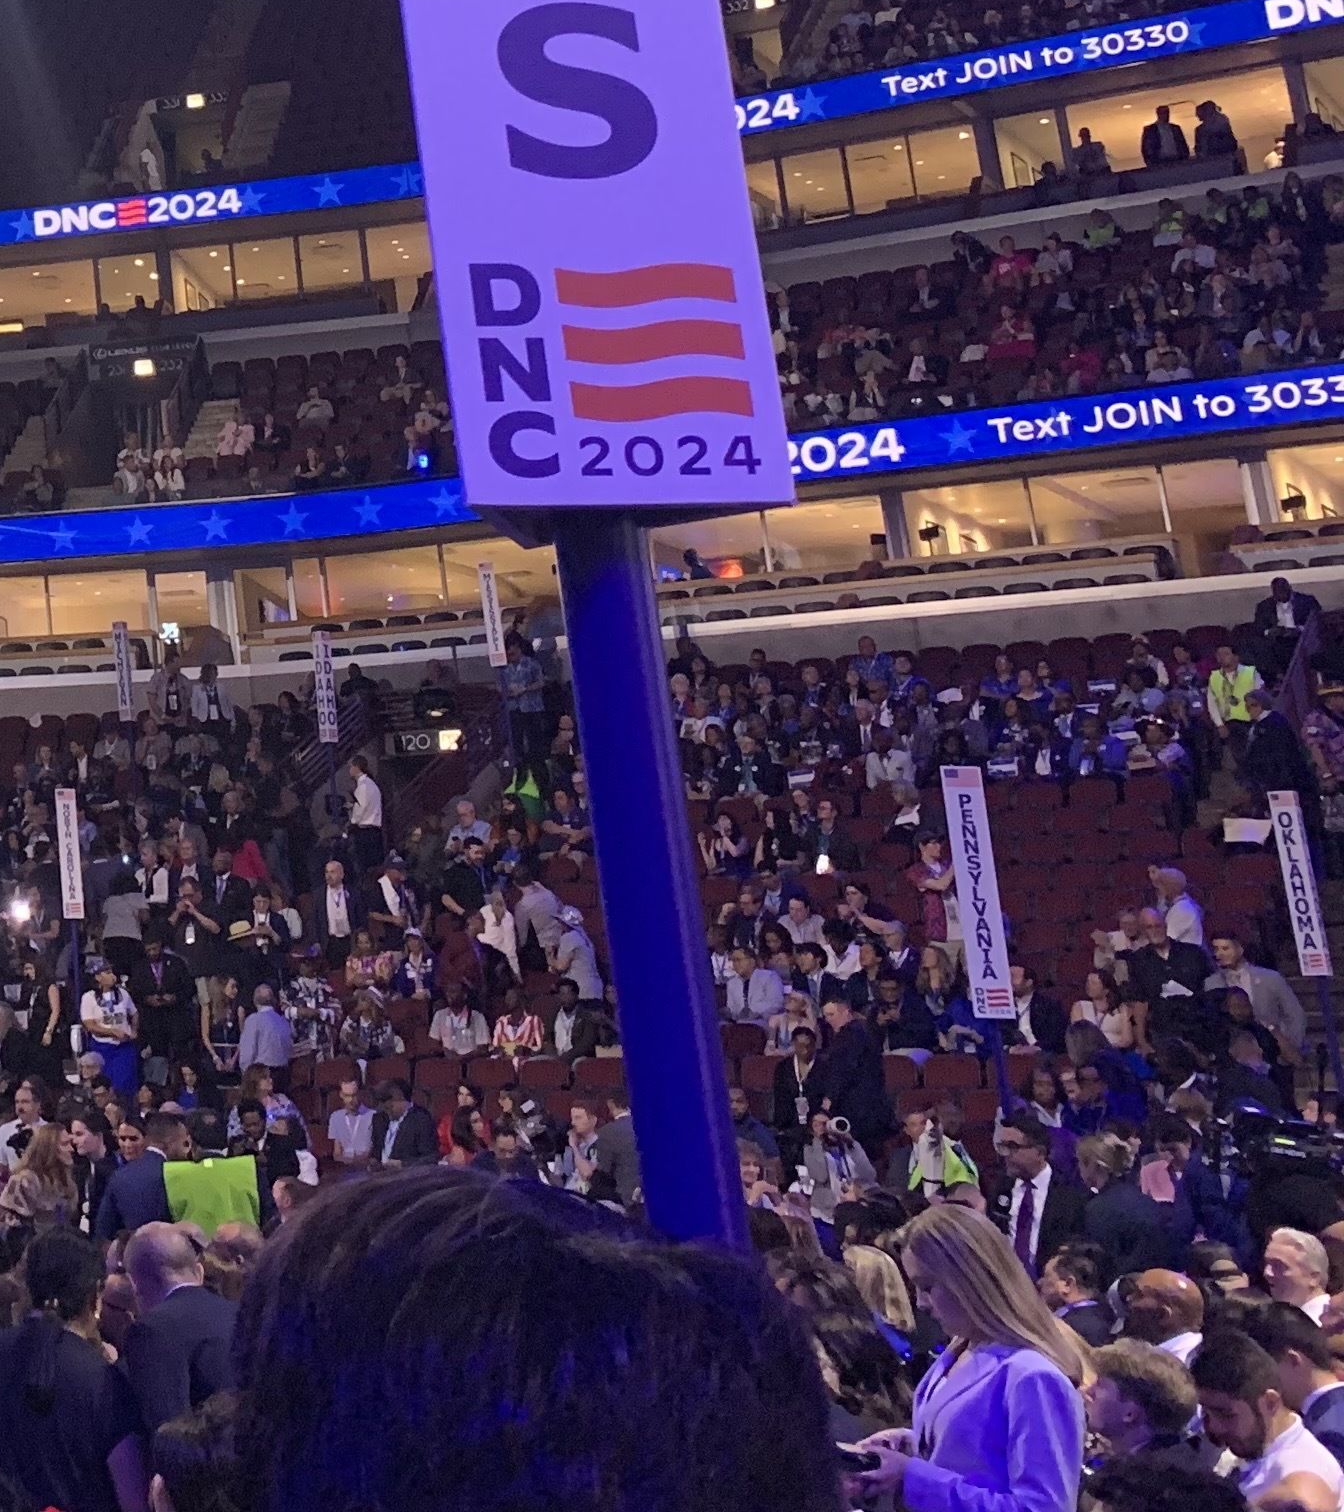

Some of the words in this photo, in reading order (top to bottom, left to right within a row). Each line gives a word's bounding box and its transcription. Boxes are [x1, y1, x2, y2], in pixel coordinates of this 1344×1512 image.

[882, 68, 947, 98] Text
[955, 52, 1034, 85] JOIN
[1040, 45, 1074, 70] to
[1081, 21, 1190, 60] 30330
[34, 203, 116, 237] DNC
[147, 189, 242, 225] 2024
[469, 263, 560, 478] DNC
[578, 434, 762, 478] 2024
[988, 411, 1071, 446] Text
[1083, 396, 1183, 435] JOIN
[1192, 391, 1236, 419] to
[323, 644, 336, 725] IDAHO
[401, 733, 431, 750] 120
[958, 794, 998, 980] PENNSYLVANIA
[1278, 811, 1317, 950] OKLAHOMA
